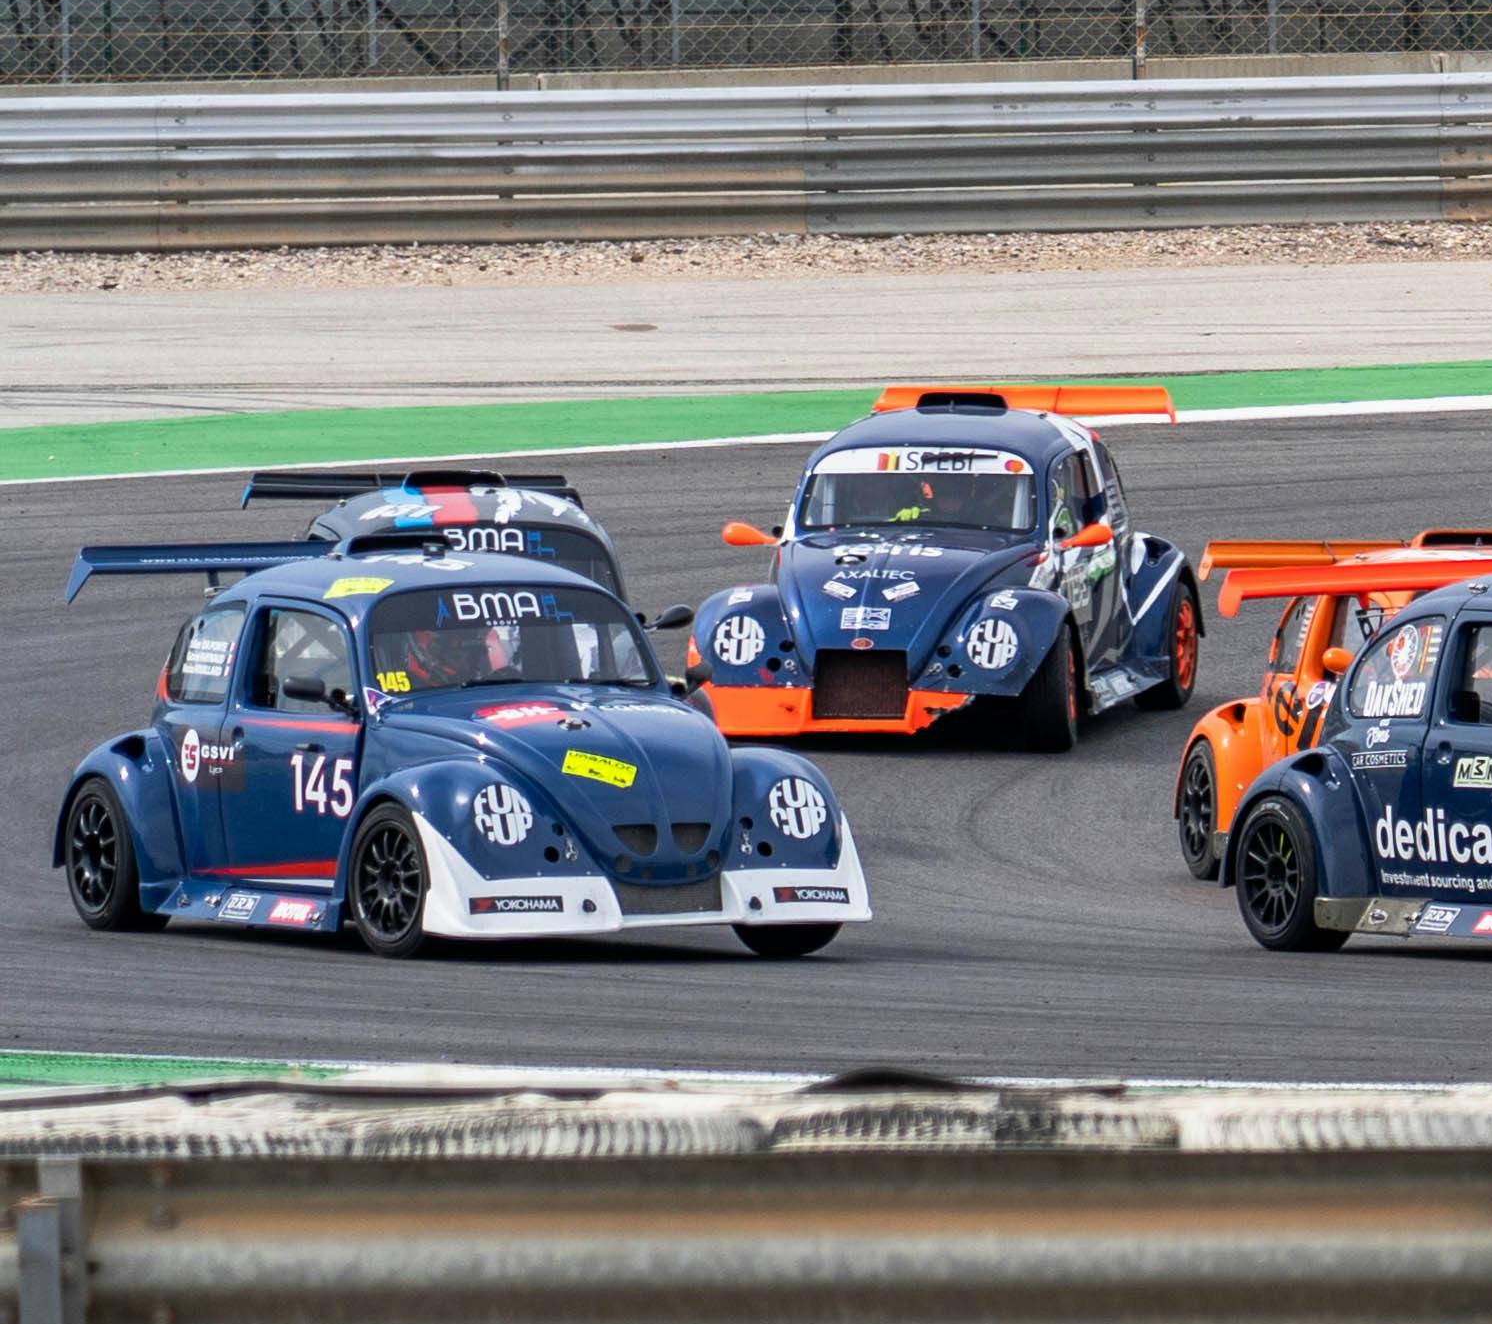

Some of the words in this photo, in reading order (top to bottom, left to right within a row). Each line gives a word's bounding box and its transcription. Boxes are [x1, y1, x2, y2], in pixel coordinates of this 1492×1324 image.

[443, 528, 524, 551] BMA
[832, 569, 916, 580] AXALTEC
[452, 592, 542, 620] BMA
[715, 616, 765, 641] FUN
[968, 620, 1018, 644] FUN
[714, 639, 765, 665] CUP
[966, 642, 1018, 669] CUP
[376, 671, 412, 693] 145
[1363, 680, 1426, 717] OAKSHED
[201, 745, 235, 761] GSVI
[1352, 756, 1364, 766] CAR
[1365, 753, 1407, 766] COSMETICS
[290, 754, 353, 818] 145
[769, 777, 826, 808] FUN
[473, 784, 532, 815] FUN
[475, 812, 533, 845] CUP
[770, 806, 827, 840] CUP
[1380, 869, 1430, 887] Investment
[1431, 874, 1476, 893] sourcing
[494, 899, 560, 912] YOKOHAMA
[794, 889, 849, 902] YOKOHAMA
